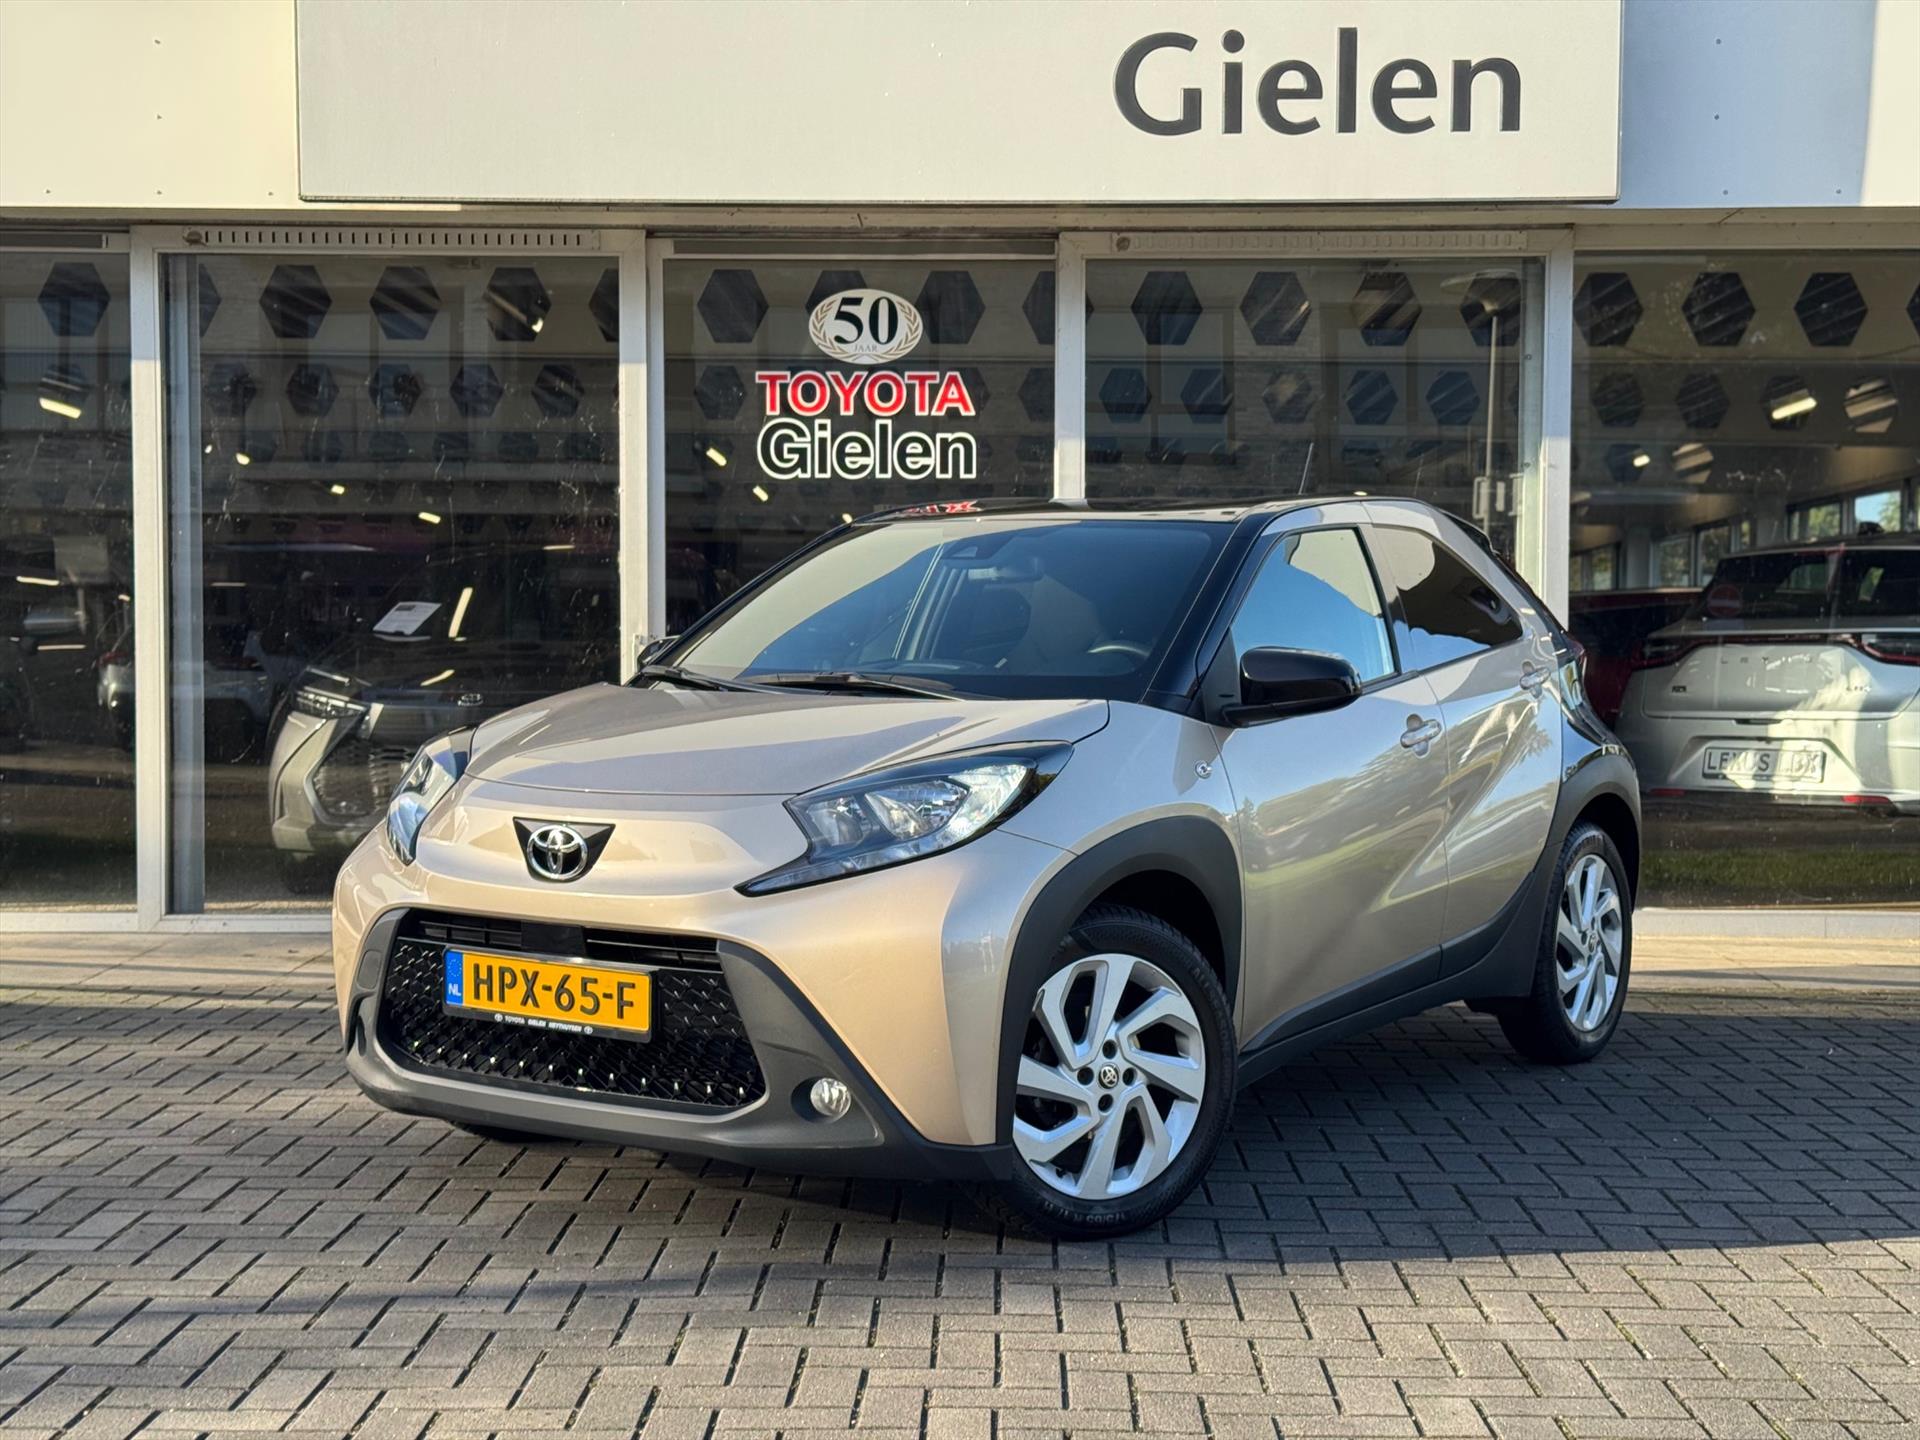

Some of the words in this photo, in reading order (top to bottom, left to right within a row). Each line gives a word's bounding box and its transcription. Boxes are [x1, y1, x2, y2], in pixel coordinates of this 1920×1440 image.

[1113, 27, 1521, 136] Gielen
[833, 296, 899, 345] 50
[854, 343, 878, 353] JAAR
[755, 371, 976, 416] TOYOTA
[757, 417, 977, 480] Gielen
[1707, 752, 1770, 772] LEXUS
[448, 983, 462, 996] NL
[473, 963, 636, 1019] HPX-65-F
